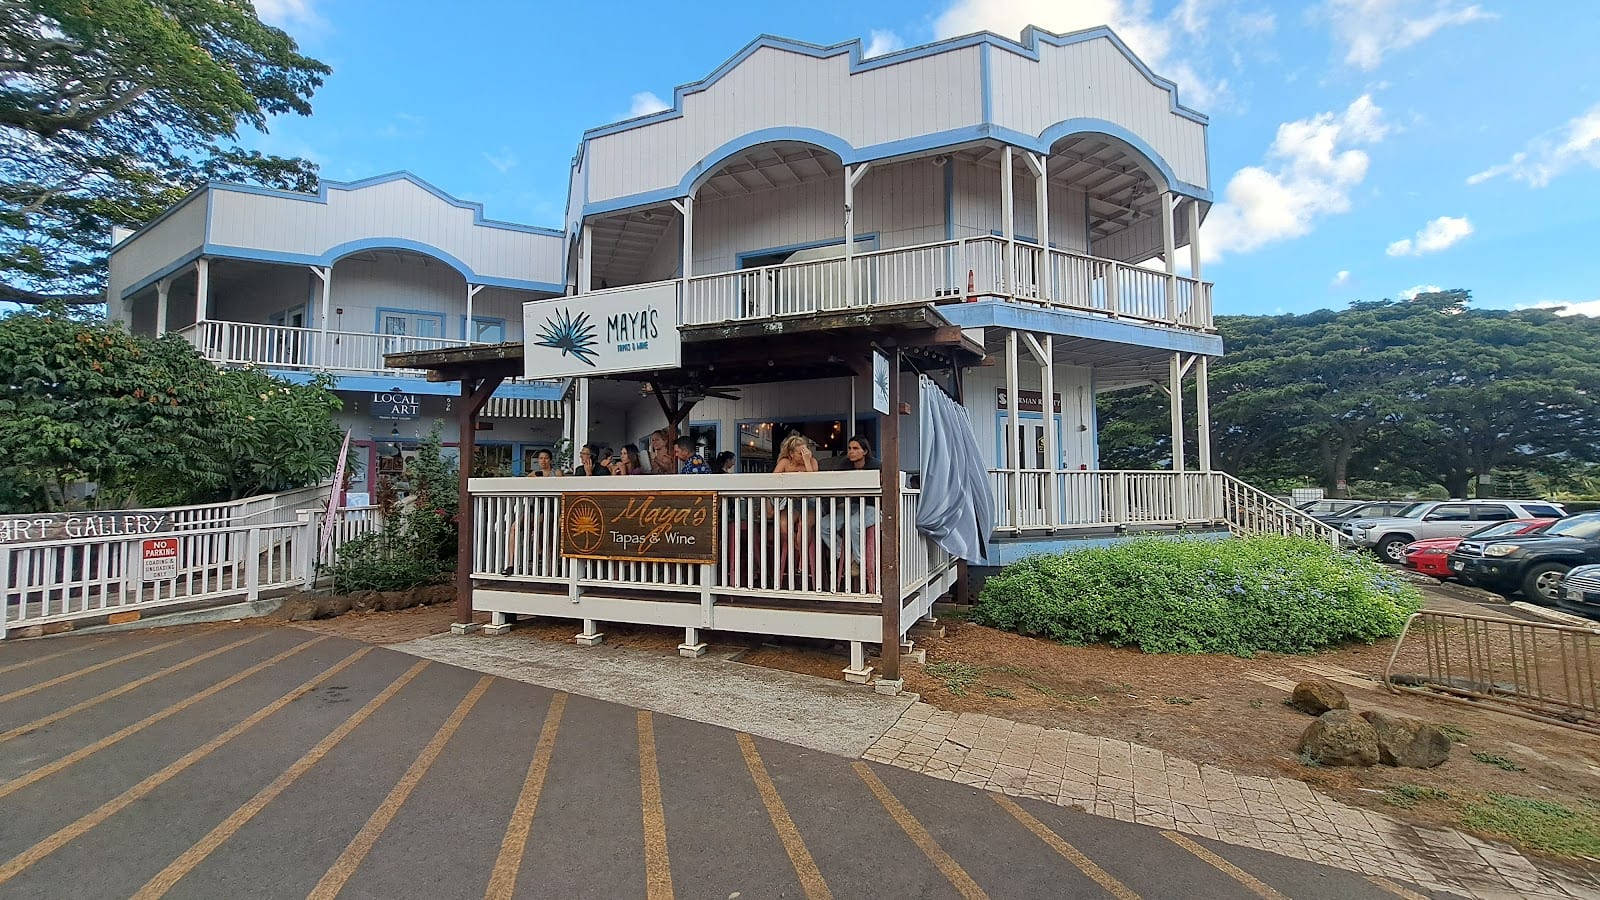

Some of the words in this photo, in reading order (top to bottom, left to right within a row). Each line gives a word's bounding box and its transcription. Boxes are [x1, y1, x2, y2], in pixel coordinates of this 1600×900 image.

[607, 304, 658, 344] MAYA'S
[374, 393, 418, 404] LOCAL
[391, 405, 418, 415] ART
[65, 515, 165, 538] GALLERY
[611, 495, 707, 554] Maya's
[153, 541, 167, 549] NO
[609, 530, 645, 550] Tapas
[649, 532, 661, 544] &
[664, 531, 696, 545] Wine
[145, 548, 175, 557] PARKING
